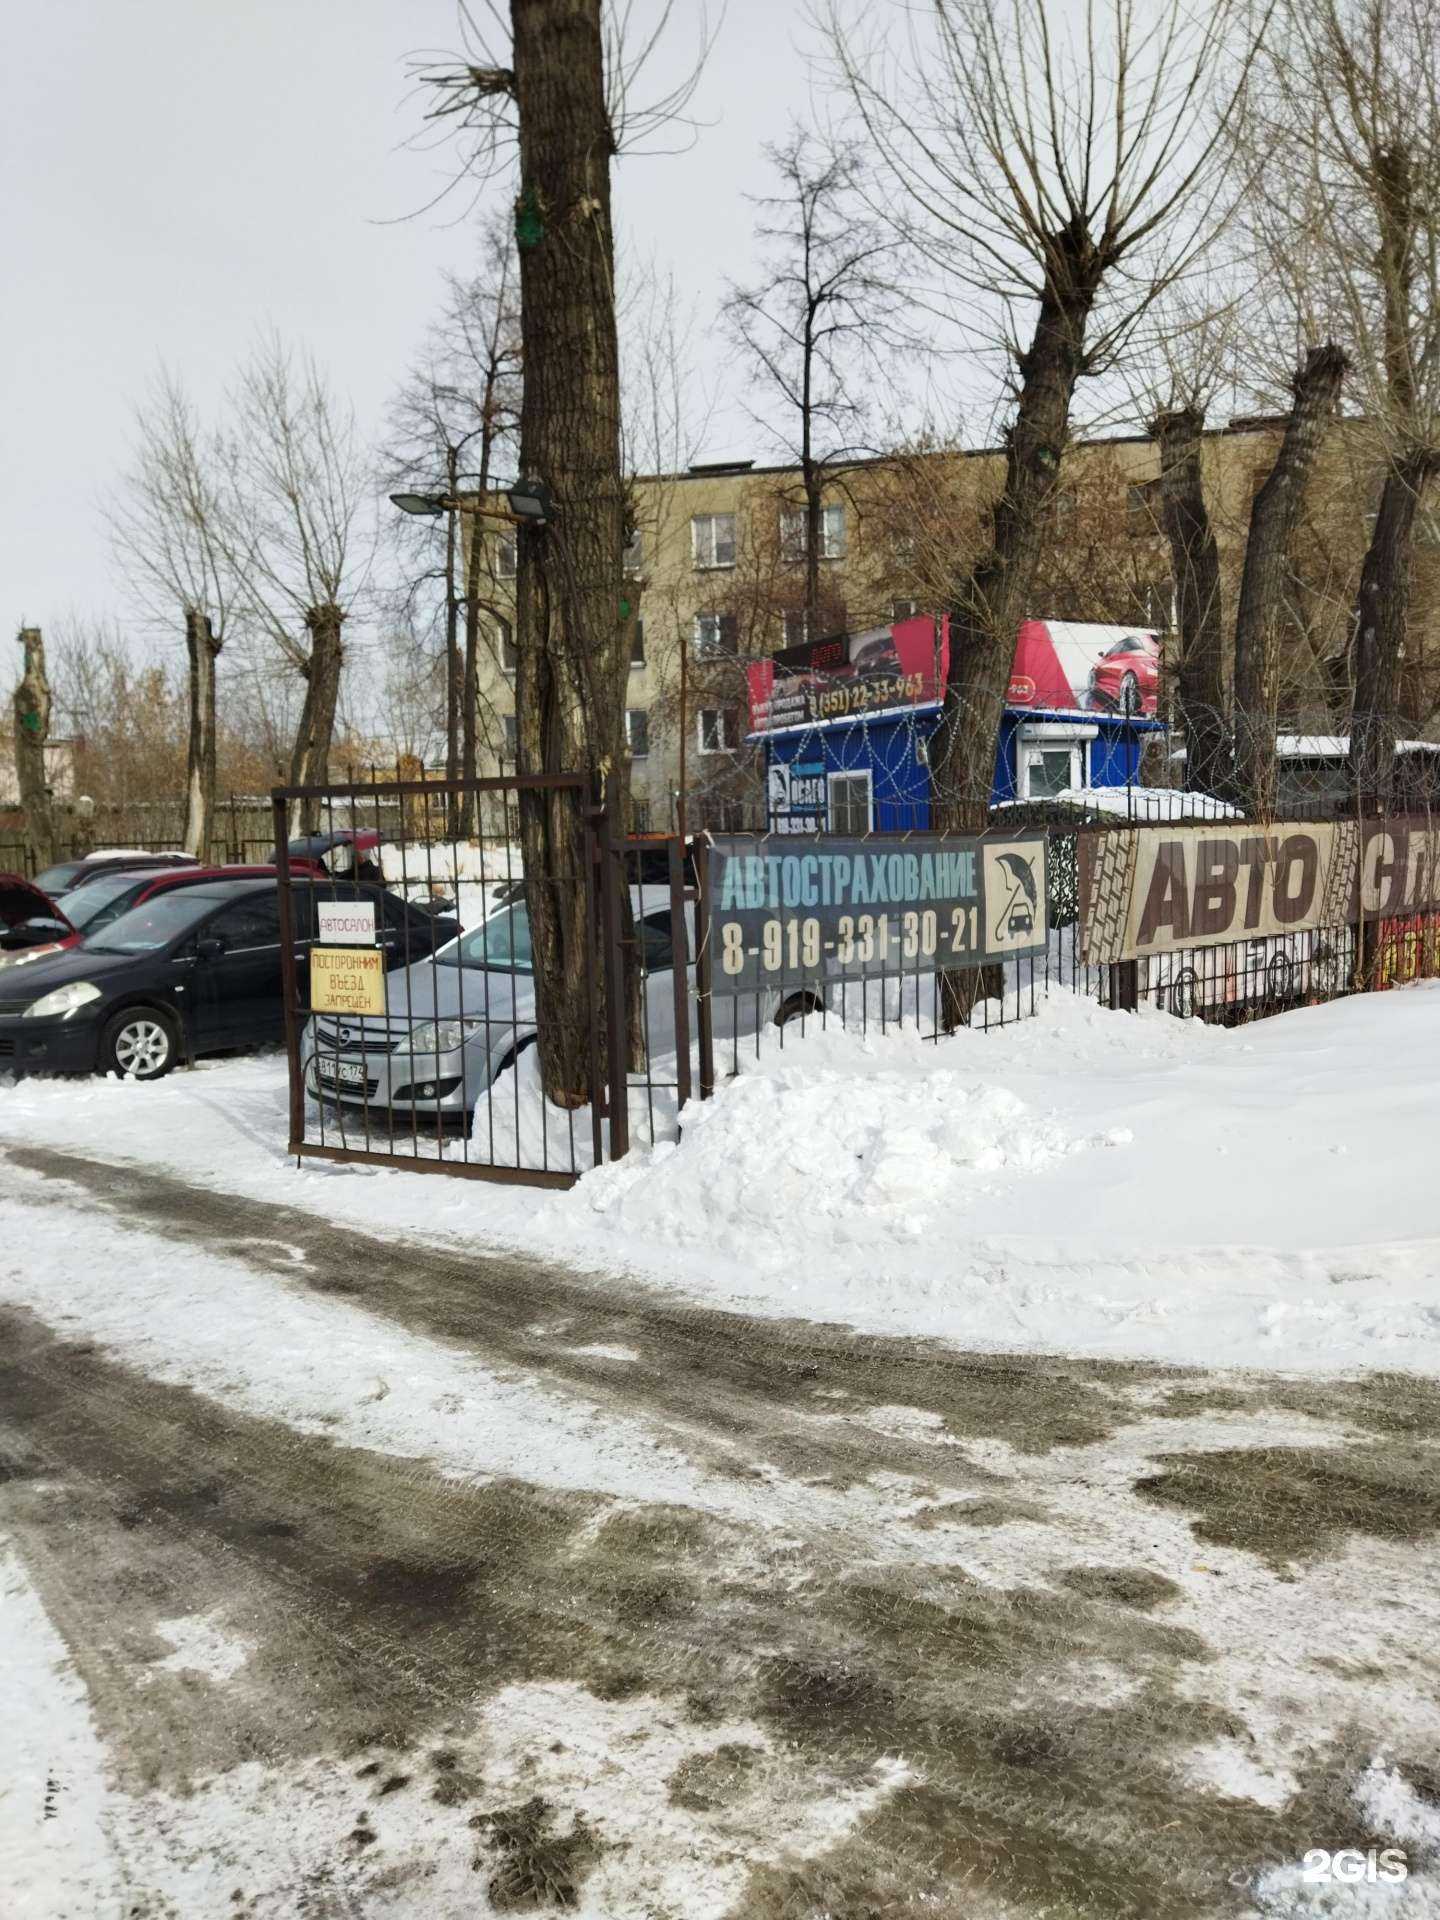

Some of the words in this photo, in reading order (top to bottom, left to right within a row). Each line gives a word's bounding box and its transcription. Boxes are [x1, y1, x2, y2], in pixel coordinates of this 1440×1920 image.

[721, 851, 978, 911] АВТОСТРАХОВАНИЕ
[1136, 834, 1319, 947] АВТО
[1361, 830, 1440, 913] СП
[320, 918, 375, 932] АВТОСАЛОН
[722, 906, 978, 975] 8-919-331-30-21
[312, 953, 379, 971] ПОСТОРОННИМ
[329, 974, 365, 991] ВЪЕЗД
[324, 993, 372, 1009] ЗАПРЕЩЕН
